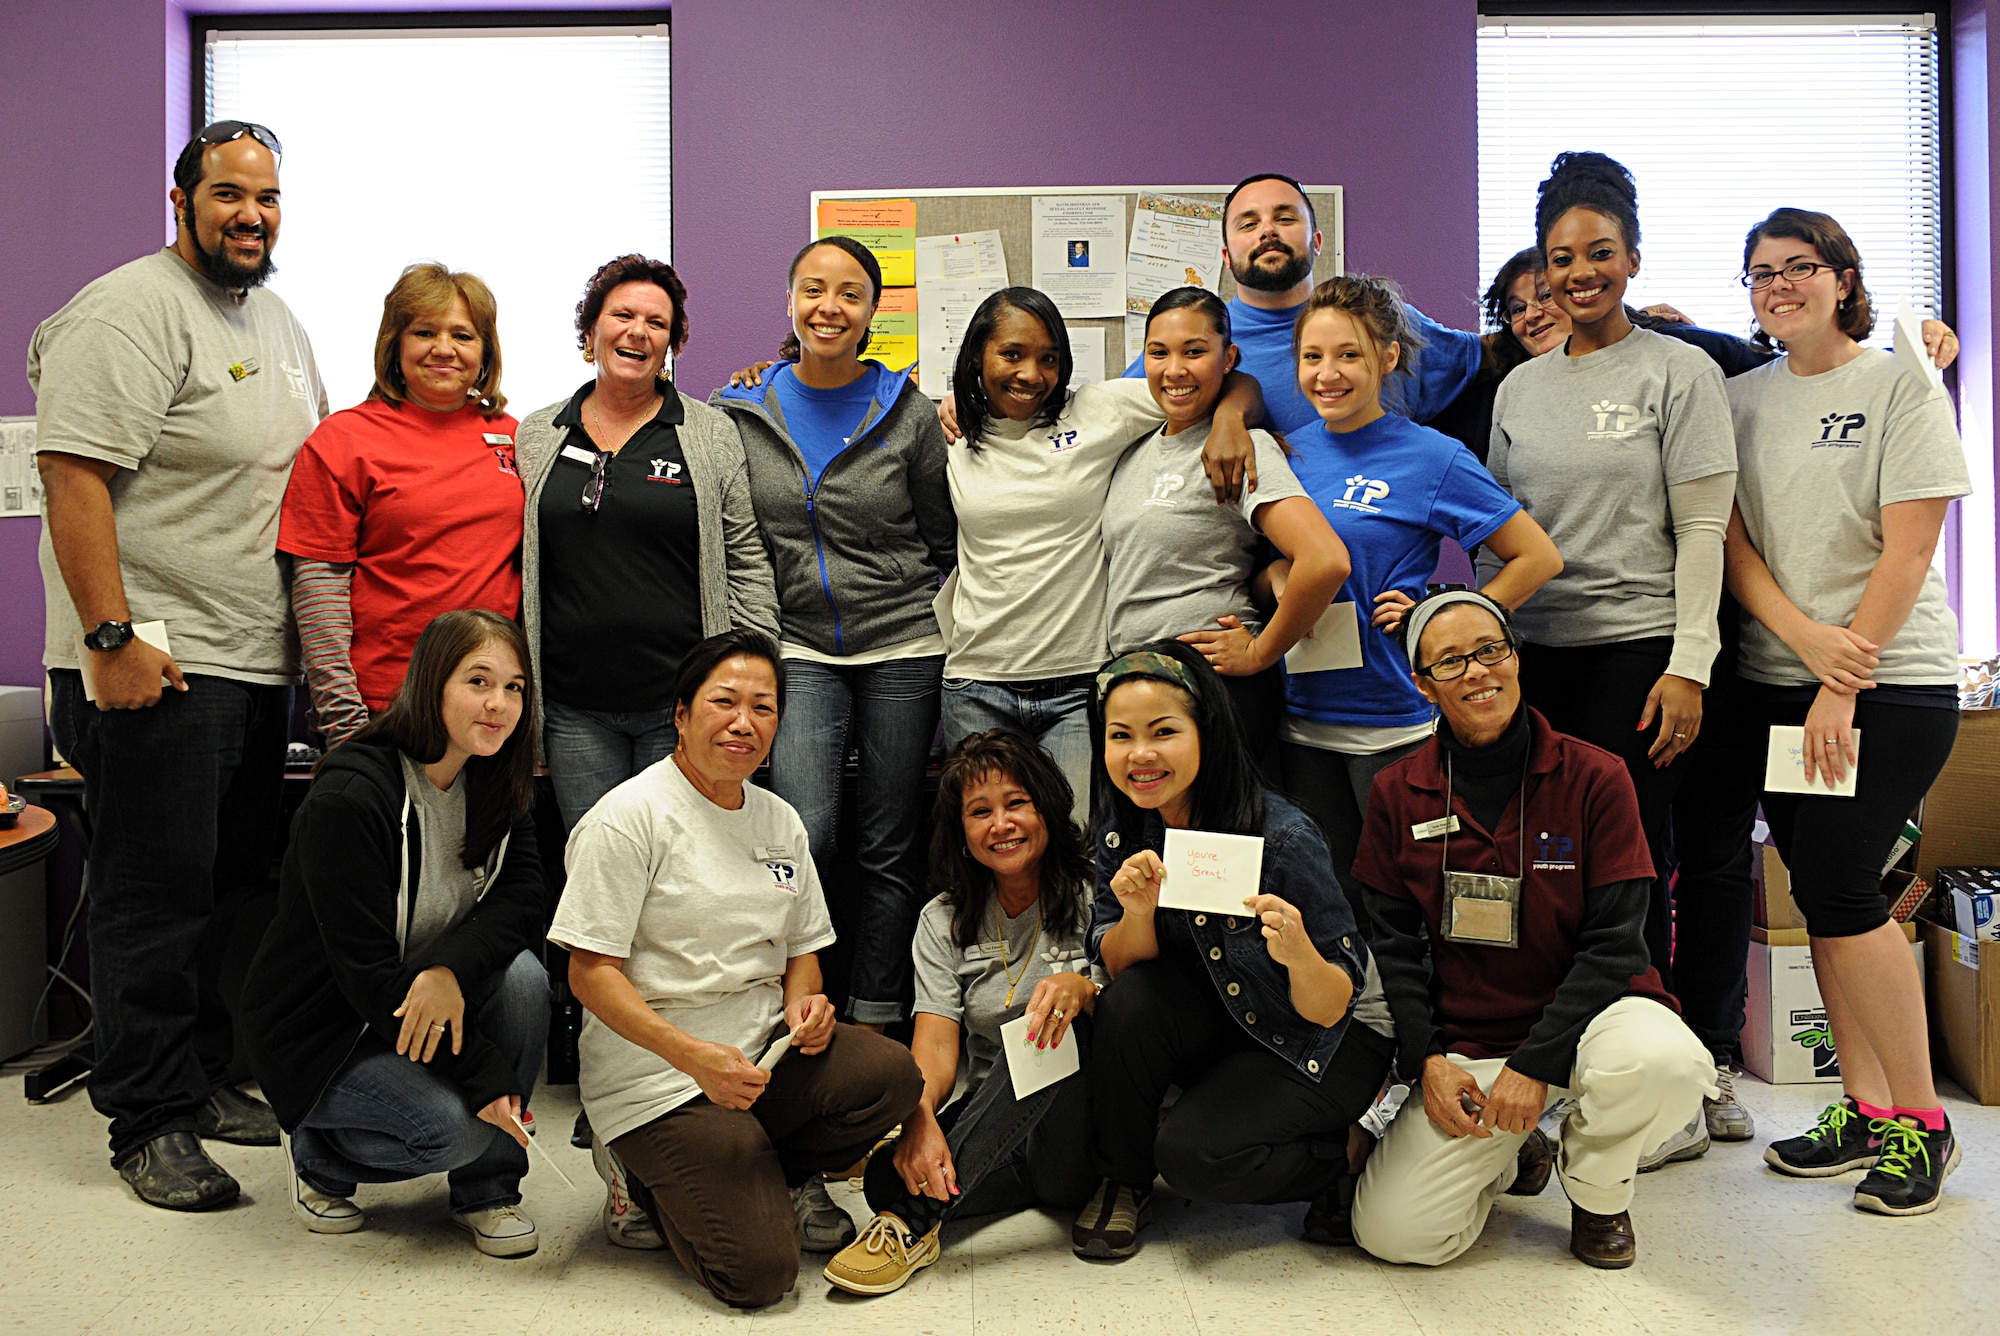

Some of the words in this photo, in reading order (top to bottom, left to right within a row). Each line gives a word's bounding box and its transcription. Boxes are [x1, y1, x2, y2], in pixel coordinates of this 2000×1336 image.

[1591, 400, 1640, 431] YP
[1820, 412, 1866, 440] YP
[1047, 430, 1077, 448] YP
[650, 458, 681, 478] YP
[1151, 473, 1184, 499] YP
[1343, 474, 1390, 505] YP
[1533, 831, 1574, 861] YP
[765, 862, 794, 885] YP
[1192, 865, 1226, 880] Great!
